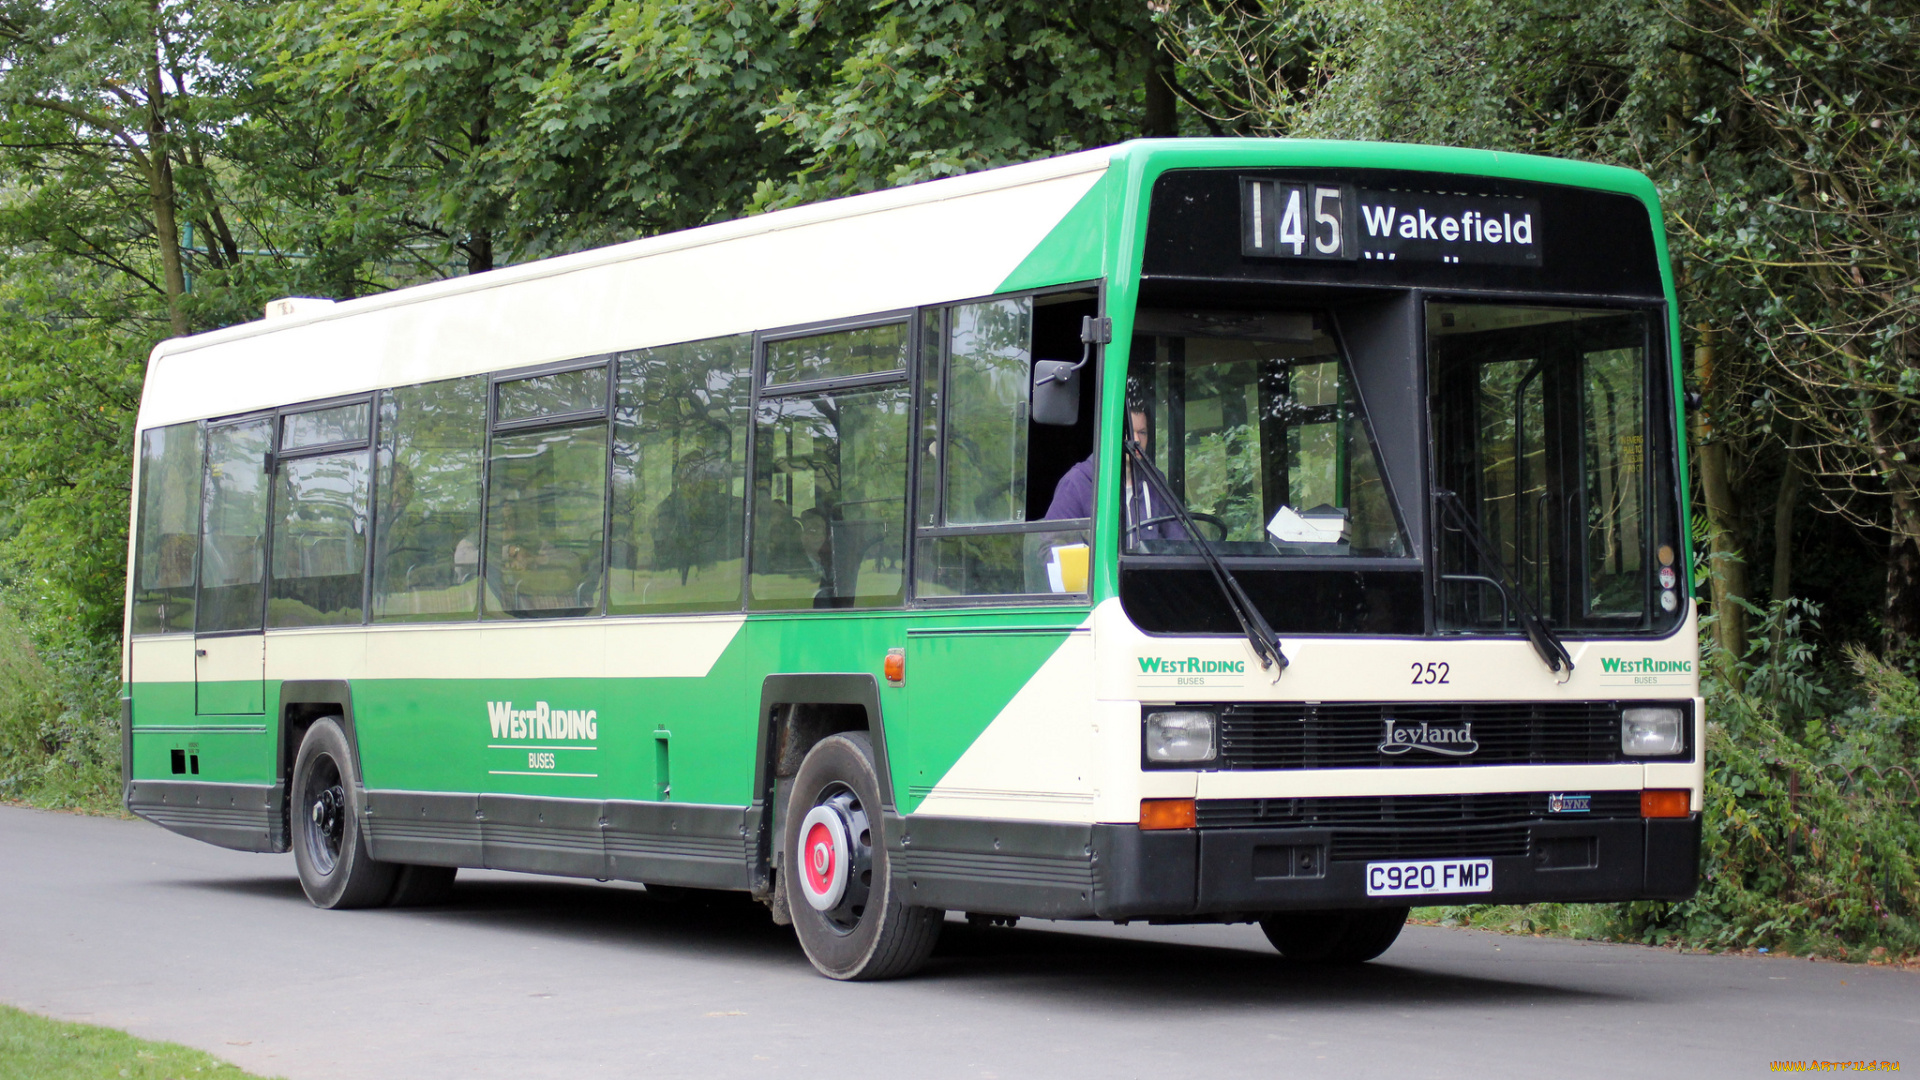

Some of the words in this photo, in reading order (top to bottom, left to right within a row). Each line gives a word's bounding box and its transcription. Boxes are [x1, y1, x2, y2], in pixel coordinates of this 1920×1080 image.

[1252, 181, 1341, 256] 145
[1361, 204, 1533, 244] Wakefield
[1177, 677, 1205, 685] BUSES
[1411, 661, 1450, 684] 252
[1634, 676, 1658, 684] BUSES
[1380, 719, 1479, 755] Leyland
[528, 752, 556, 769] BUSES
[1562, 799, 1589, 809] LYNX
[1370, 865, 1435, 890] C920
[1443, 863, 1489, 888] FMP
